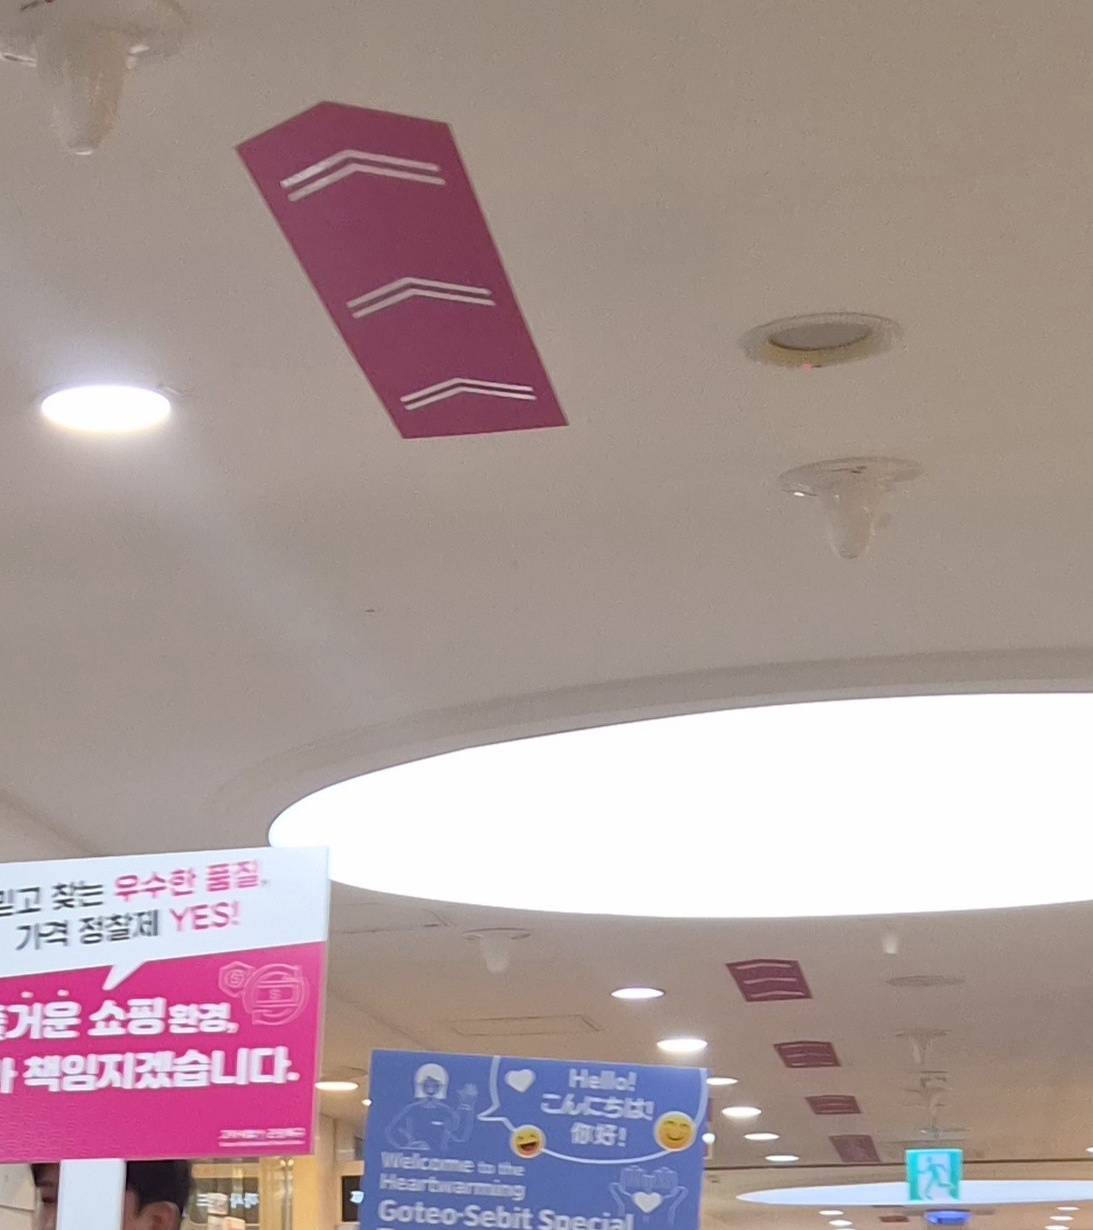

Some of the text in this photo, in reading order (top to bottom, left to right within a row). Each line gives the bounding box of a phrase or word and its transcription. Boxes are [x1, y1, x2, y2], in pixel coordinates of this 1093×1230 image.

[51, 880, 104, 911] 찾는
[114, 868, 197, 901] 우수한
[15, 900, 240, 950] 가격 정찰제 YES!
[23, 1046, 300, 1093] 책임지겠습니다.
[569, 1068, 637, 1092] Hello!
[380, 1151, 525, 1177] Welcome to the
[379, 1173, 526, 1201] Heartwarming
